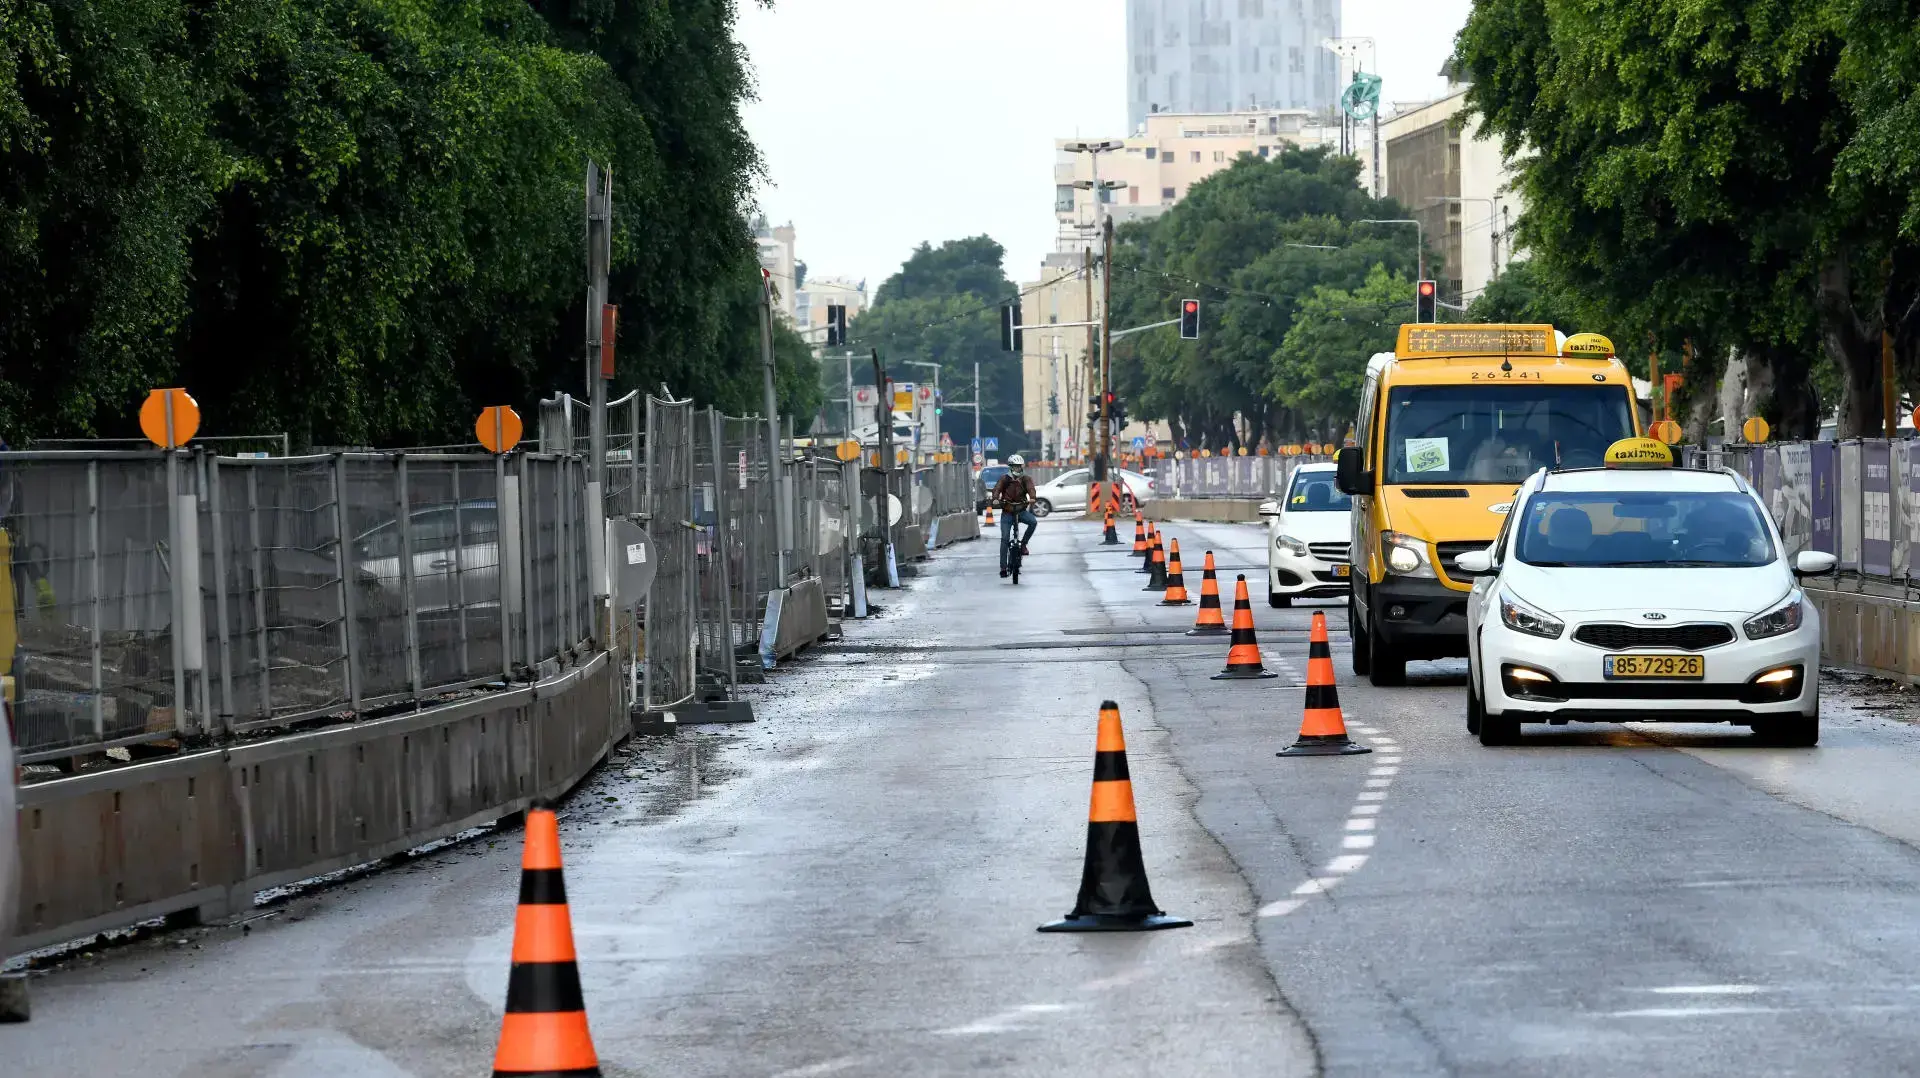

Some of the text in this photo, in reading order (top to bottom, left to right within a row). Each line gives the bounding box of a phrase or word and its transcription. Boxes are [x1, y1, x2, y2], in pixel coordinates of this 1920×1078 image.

[1570, 343, 1610, 352] taxi מונית
[1615, 447, 1666, 460] taxi מונית
[1644, 612, 1664, 620] KIA
